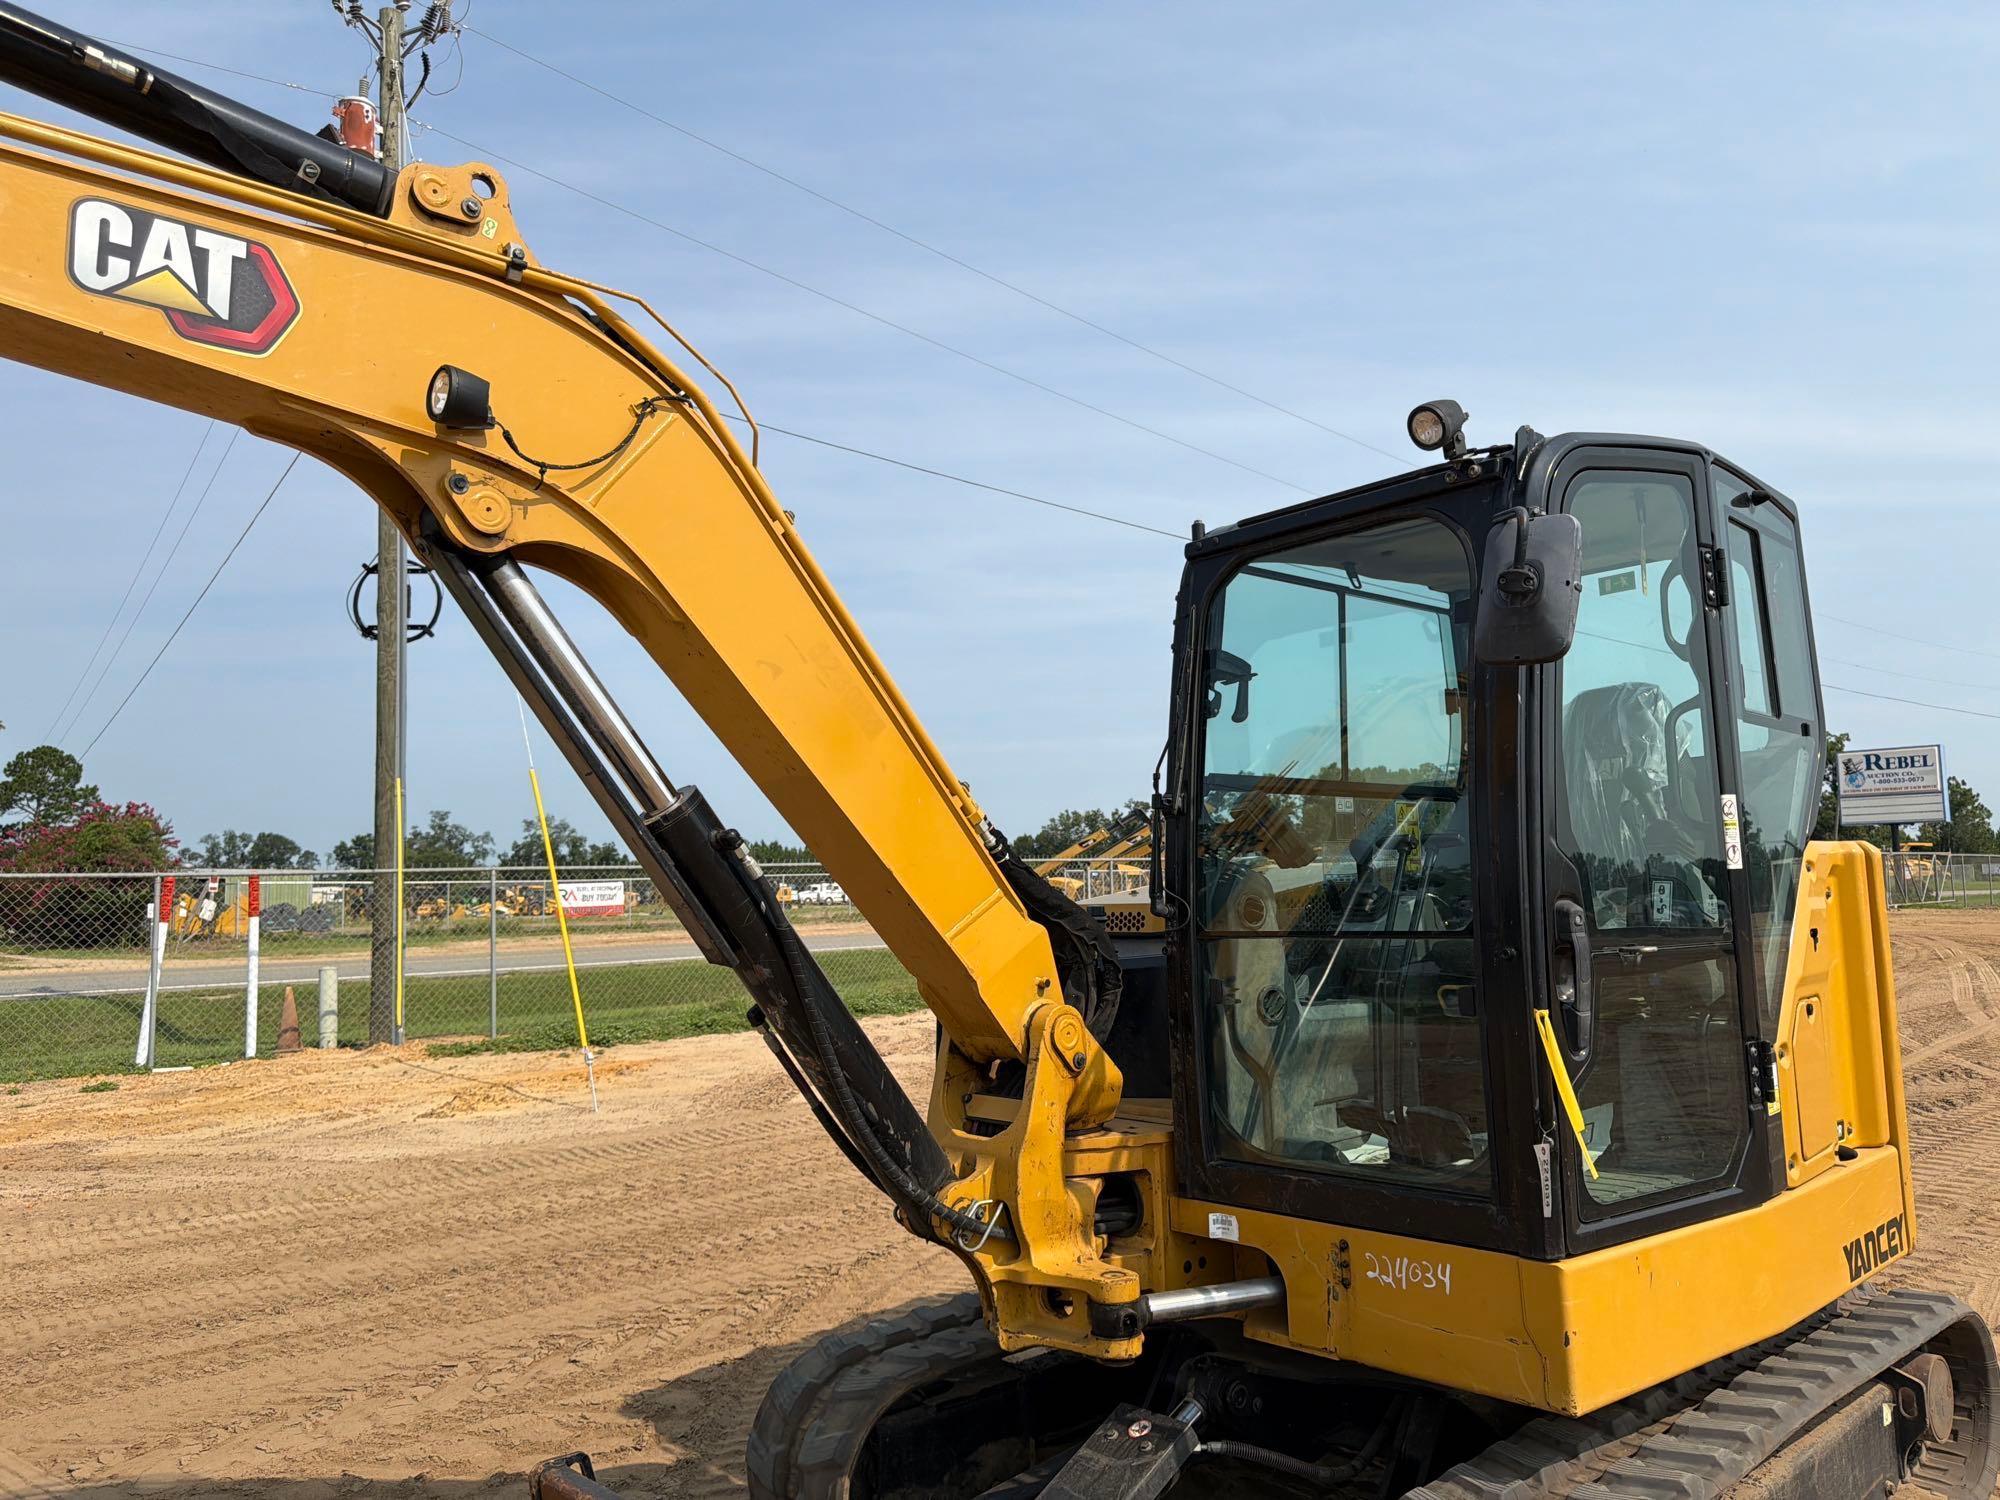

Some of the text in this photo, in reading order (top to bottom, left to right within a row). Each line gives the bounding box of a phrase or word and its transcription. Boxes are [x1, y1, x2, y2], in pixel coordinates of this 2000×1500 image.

[73, 200, 247, 321] CAT
[1863, 753, 1934, 771] REBEL
[1542, 1159, 1550, 1207] 224034
[1842, 1212, 1904, 1283] YANCEY
[1365, 1252, 1451, 1296] 224034
